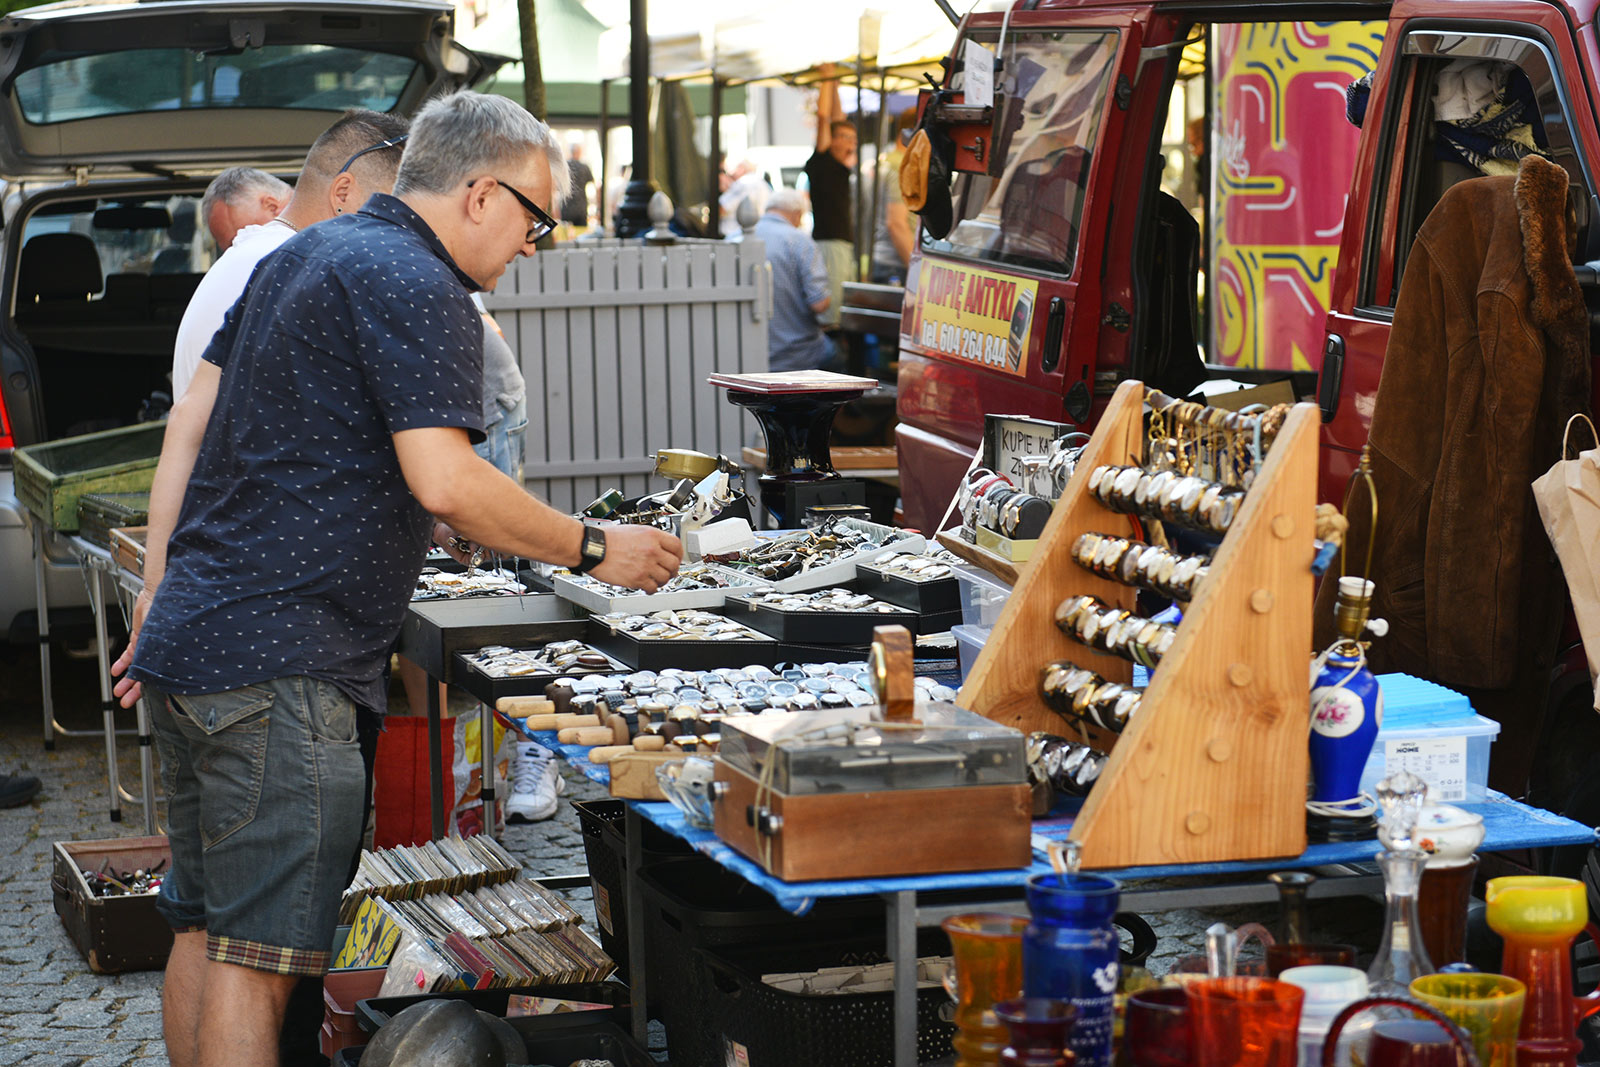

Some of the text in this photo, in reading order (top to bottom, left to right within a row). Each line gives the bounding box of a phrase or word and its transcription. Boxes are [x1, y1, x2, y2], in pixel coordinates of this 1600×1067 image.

[927, 266, 1017, 322] KUPIĘ ANTYKI
[940, 322, 961, 355] 604
[962, 328, 984, 362] 264
[984, 333, 1008, 369] 844
